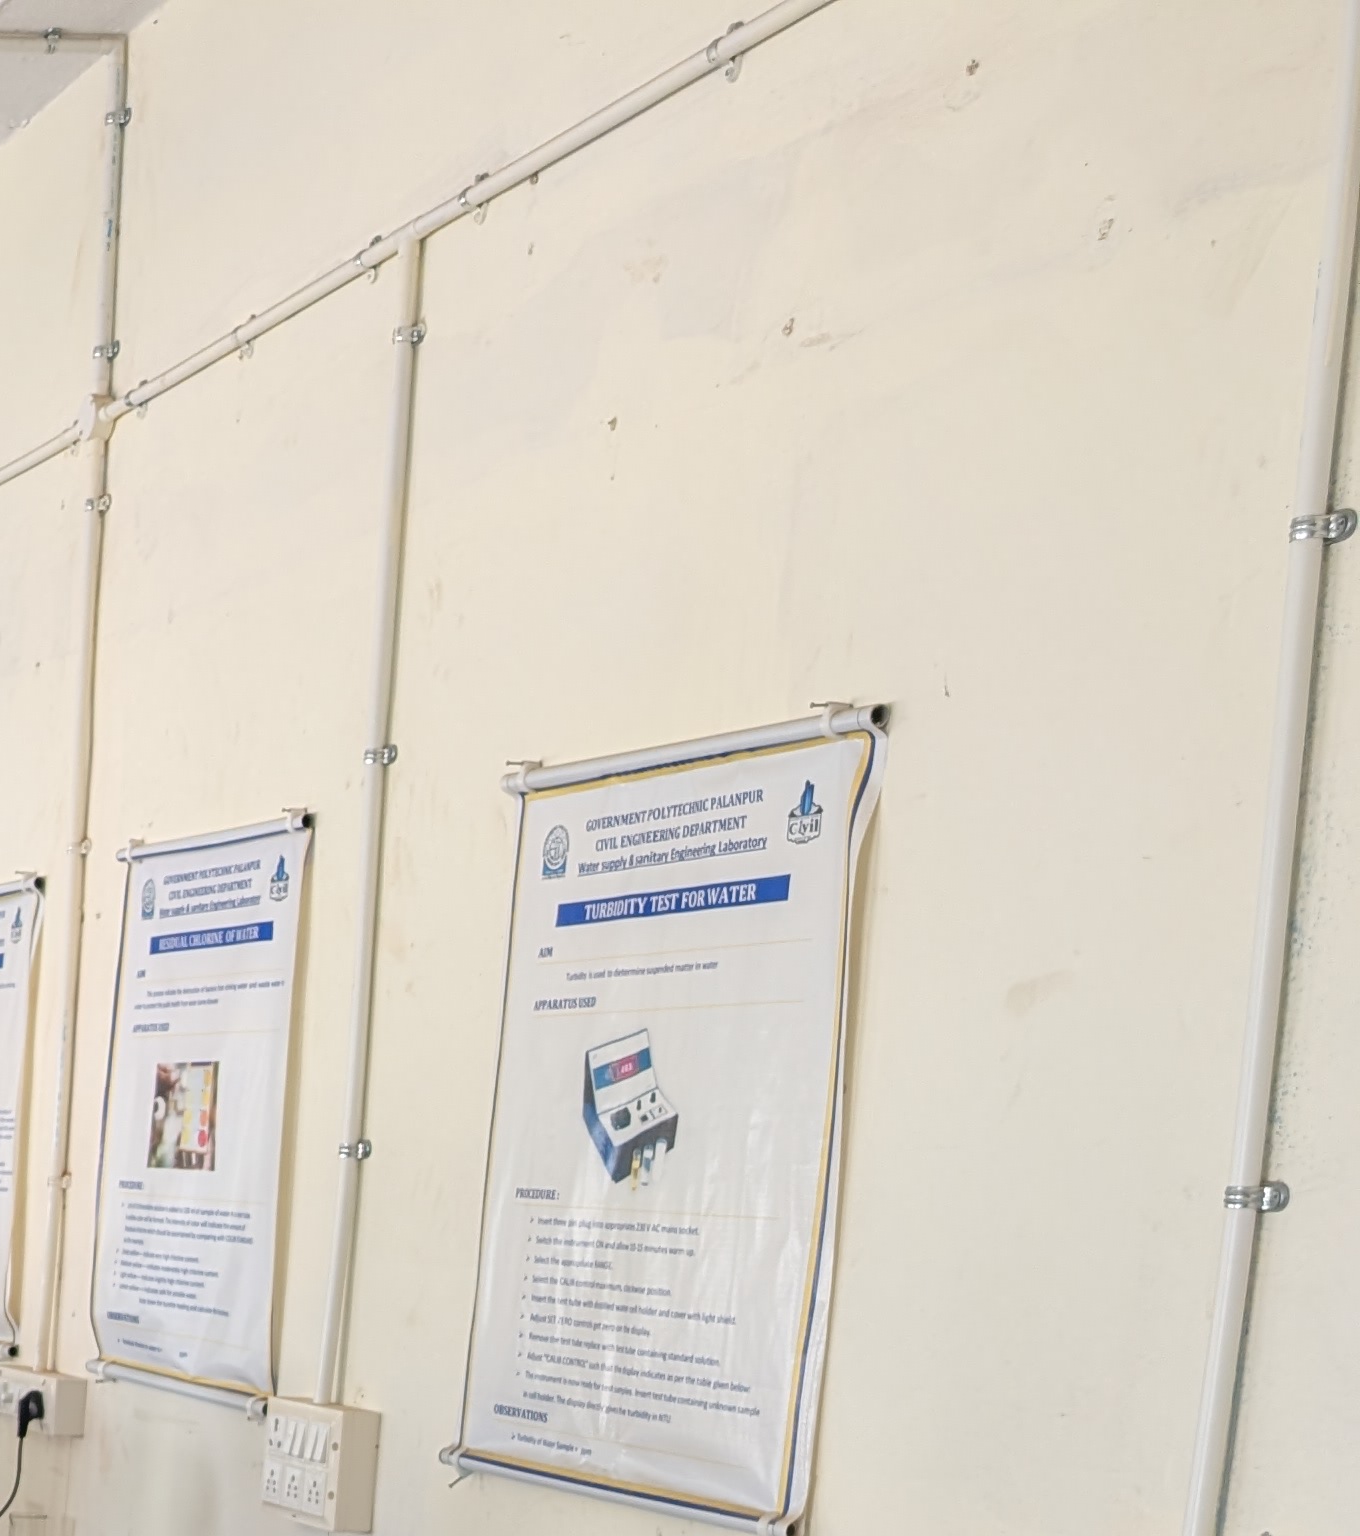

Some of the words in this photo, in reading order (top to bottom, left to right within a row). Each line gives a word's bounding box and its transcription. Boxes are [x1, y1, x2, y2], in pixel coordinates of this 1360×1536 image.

[586, 810, 647, 832] GOVERNMENT
[647, 798, 709, 821] POLYTECHNIC
[710, 789, 764, 811] PALANPUR
[595, 836, 618, 852] CIVIL
[620, 826, 681, 849] ENGINEERING
[682, 815, 747, 838] DEPARTMENT
[578, 862, 600, 874] Water
[671, 843, 716, 861] Engineering
[718, 836, 767, 853] Laboratory
[584, 896, 648, 921] TURBIDITY
[650, 893, 680, 913] TEST
[681, 889, 706, 909] FOR
[707, 883, 756, 905] WATER
[538, 946, 553, 958] AIM
[534, 998, 578, 1011] APPARATUS
[494, 1403, 549, 1423] OBSERVATIONS
